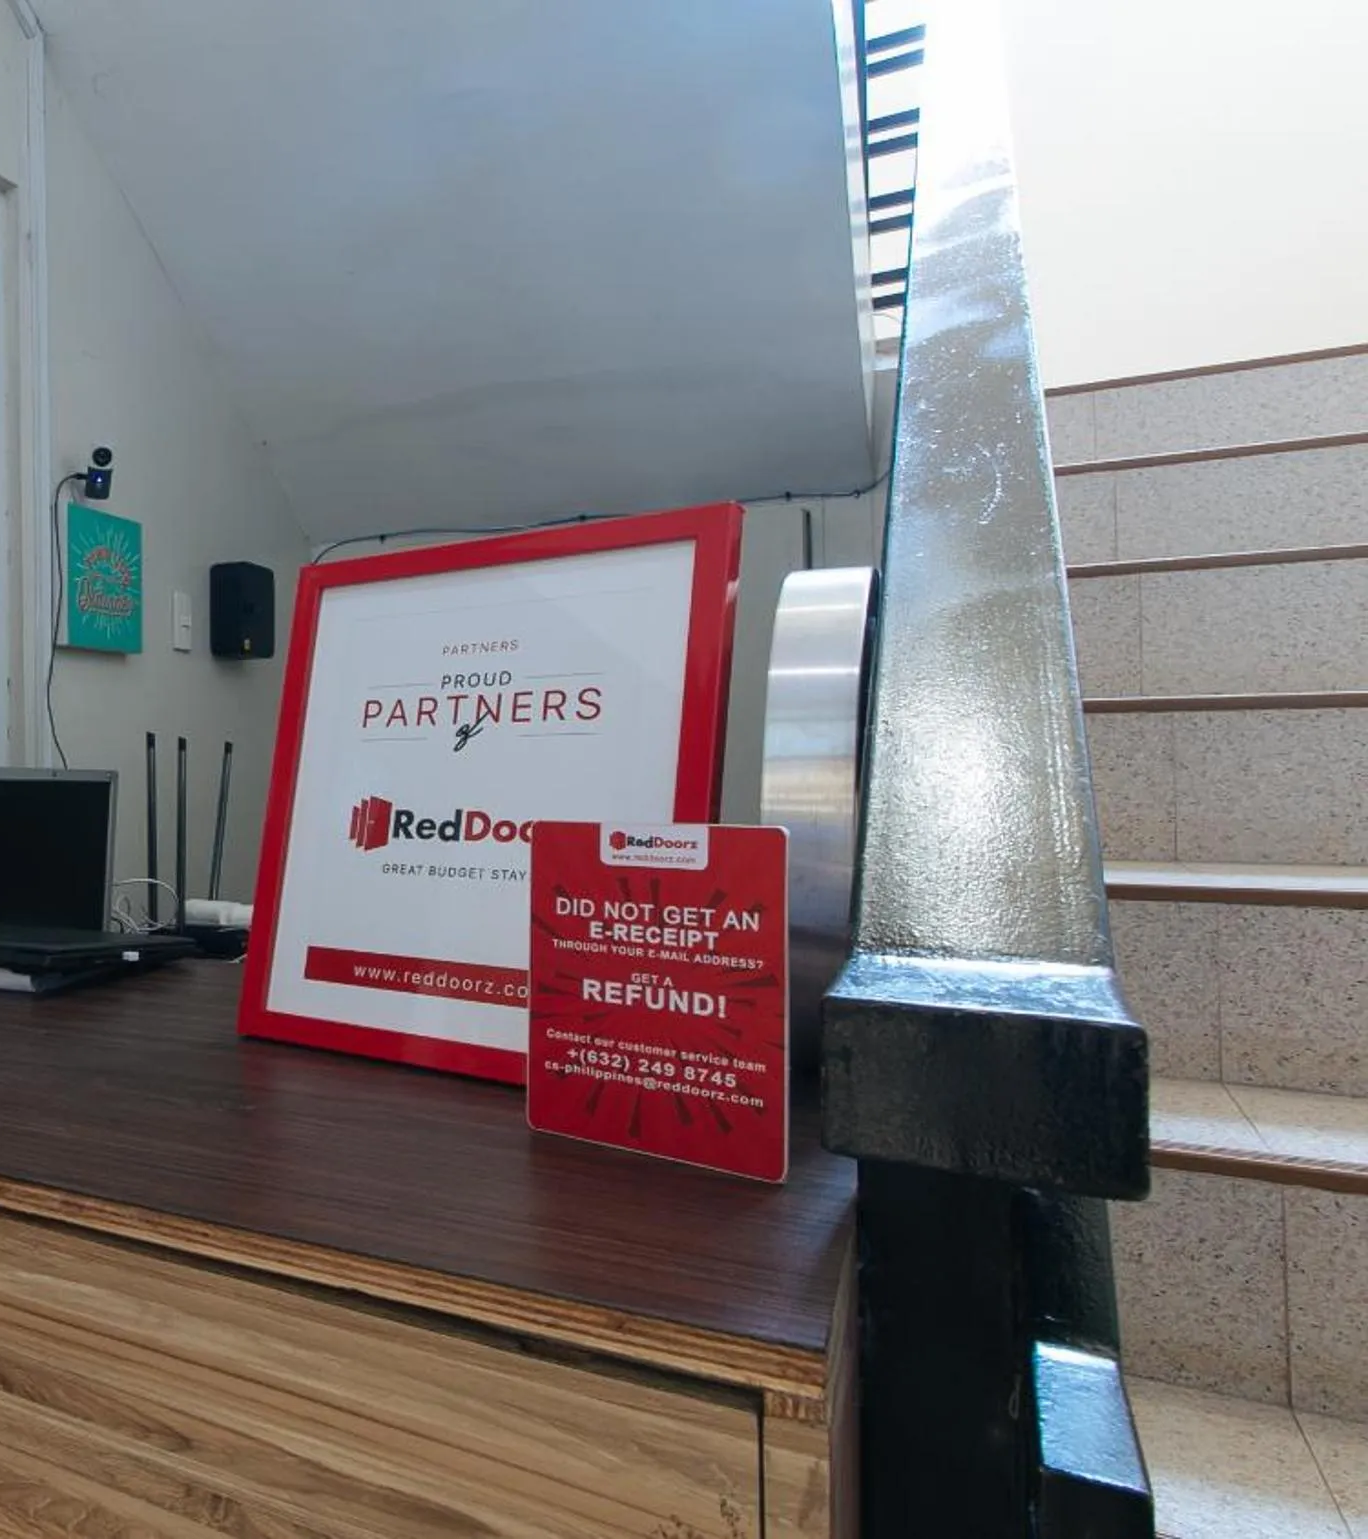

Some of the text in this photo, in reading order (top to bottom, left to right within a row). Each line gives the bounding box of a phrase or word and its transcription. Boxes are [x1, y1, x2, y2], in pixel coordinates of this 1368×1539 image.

[442, 640, 519, 656] PARTNERS
[440, 671, 512, 689] PROUD
[362, 687, 603, 728] PARTNERS
[627, 836, 699, 849] RedDoorz
[382, 863, 423, 876] GREAT
[428, 865, 484, 879] BUDGET
[556, 897, 760, 932] DID NOT GET AN
[589, 921, 719, 950] E-RECEIPT
[552, 938, 764, 970] THROUGH YOUR E-MAIL ADDRESS?
[631, 972, 674, 988] GET A
[583, 978, 727, 1018] REFUND!
[546, 1028, 767, 1073] Contact our customer service team
[544, 1059, 764, 1108] cs-philippines@reddoorz.com
[567, 1049, 736, 1088] +(632) 249 8745
